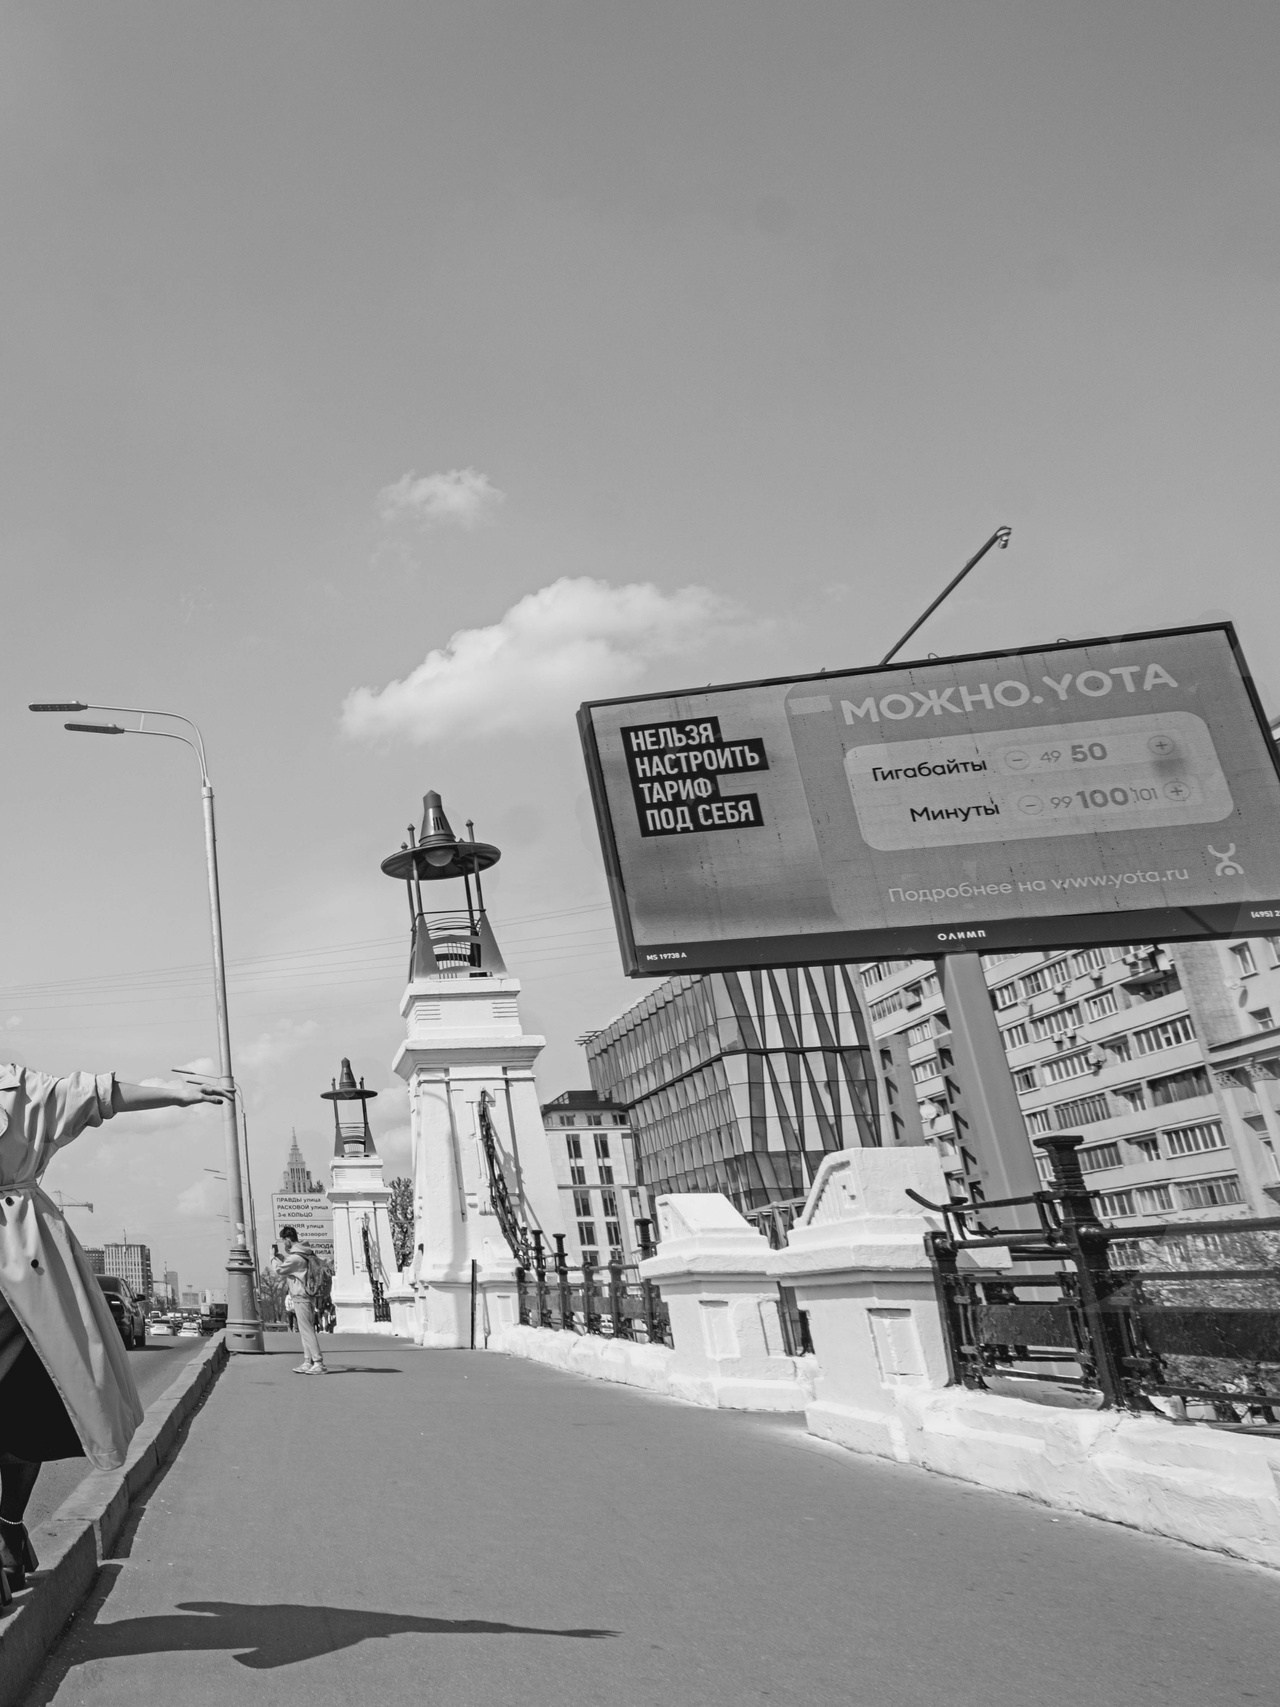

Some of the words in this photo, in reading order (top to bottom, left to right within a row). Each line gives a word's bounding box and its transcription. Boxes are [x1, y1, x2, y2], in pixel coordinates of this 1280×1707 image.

[840, 663, 1178, 725] МОЖНО.YOTA
[630, 723, 715, 751] НЕЛЬЗЯ
[635, 746, 760, 778] НАСТРОИТЬ
[872, 759, 988, 781] Гигабайты
[1040, 750, 1062, 763] 49
[1071, 742, 1108, 763] 50
[639, 777, 713, 804] ТАРИФ
[910, 804, 1000, 823] Минуты
[1050, 795, 1073, 809] 99
[1076, 787, 1129, 809] 100
[646, 806, 694, 832] ПОД
[698, 800, 755, 826] СЕБЯ
[888, 882, 1013, 903] Подробнее
[1018, 879, 1047, 893] на
[1051, 868, 1189, 890] www.yota.ru
[937, 929, 987, 941] ОЛИМП
